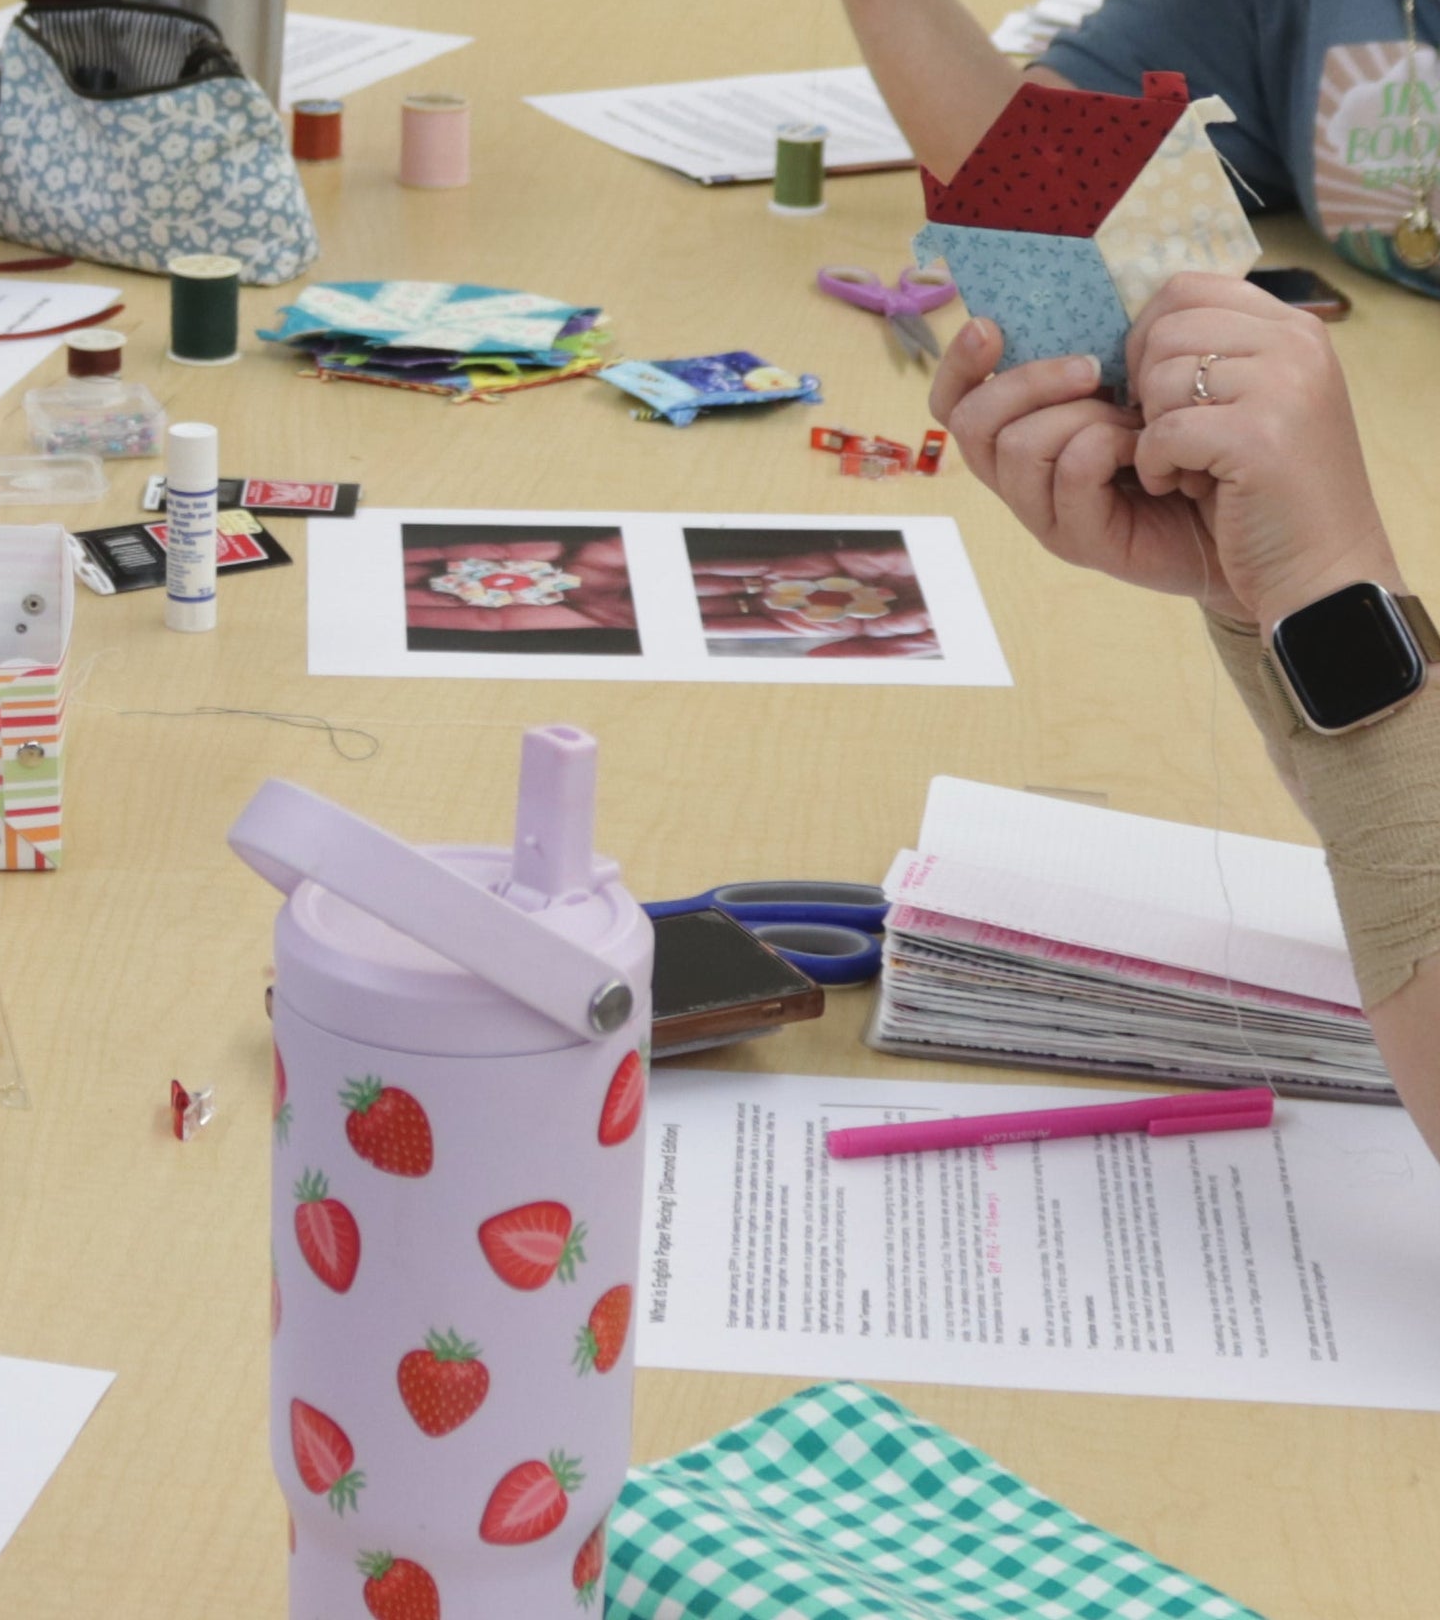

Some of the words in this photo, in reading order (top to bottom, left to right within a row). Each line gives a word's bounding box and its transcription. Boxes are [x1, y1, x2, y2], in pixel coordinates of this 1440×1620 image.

[661, 1123, 680, 1154] Edition)
[658, 1154, 676, 1194] (Diamond
[655, 1195, 677, 1230] Piecing?
[654, 1231, 672, 1256] Paper
[651, 1258, 672, 1288] English
[654, 1289, 668, 1298] is
[649, 1298, 667, 1323] What
